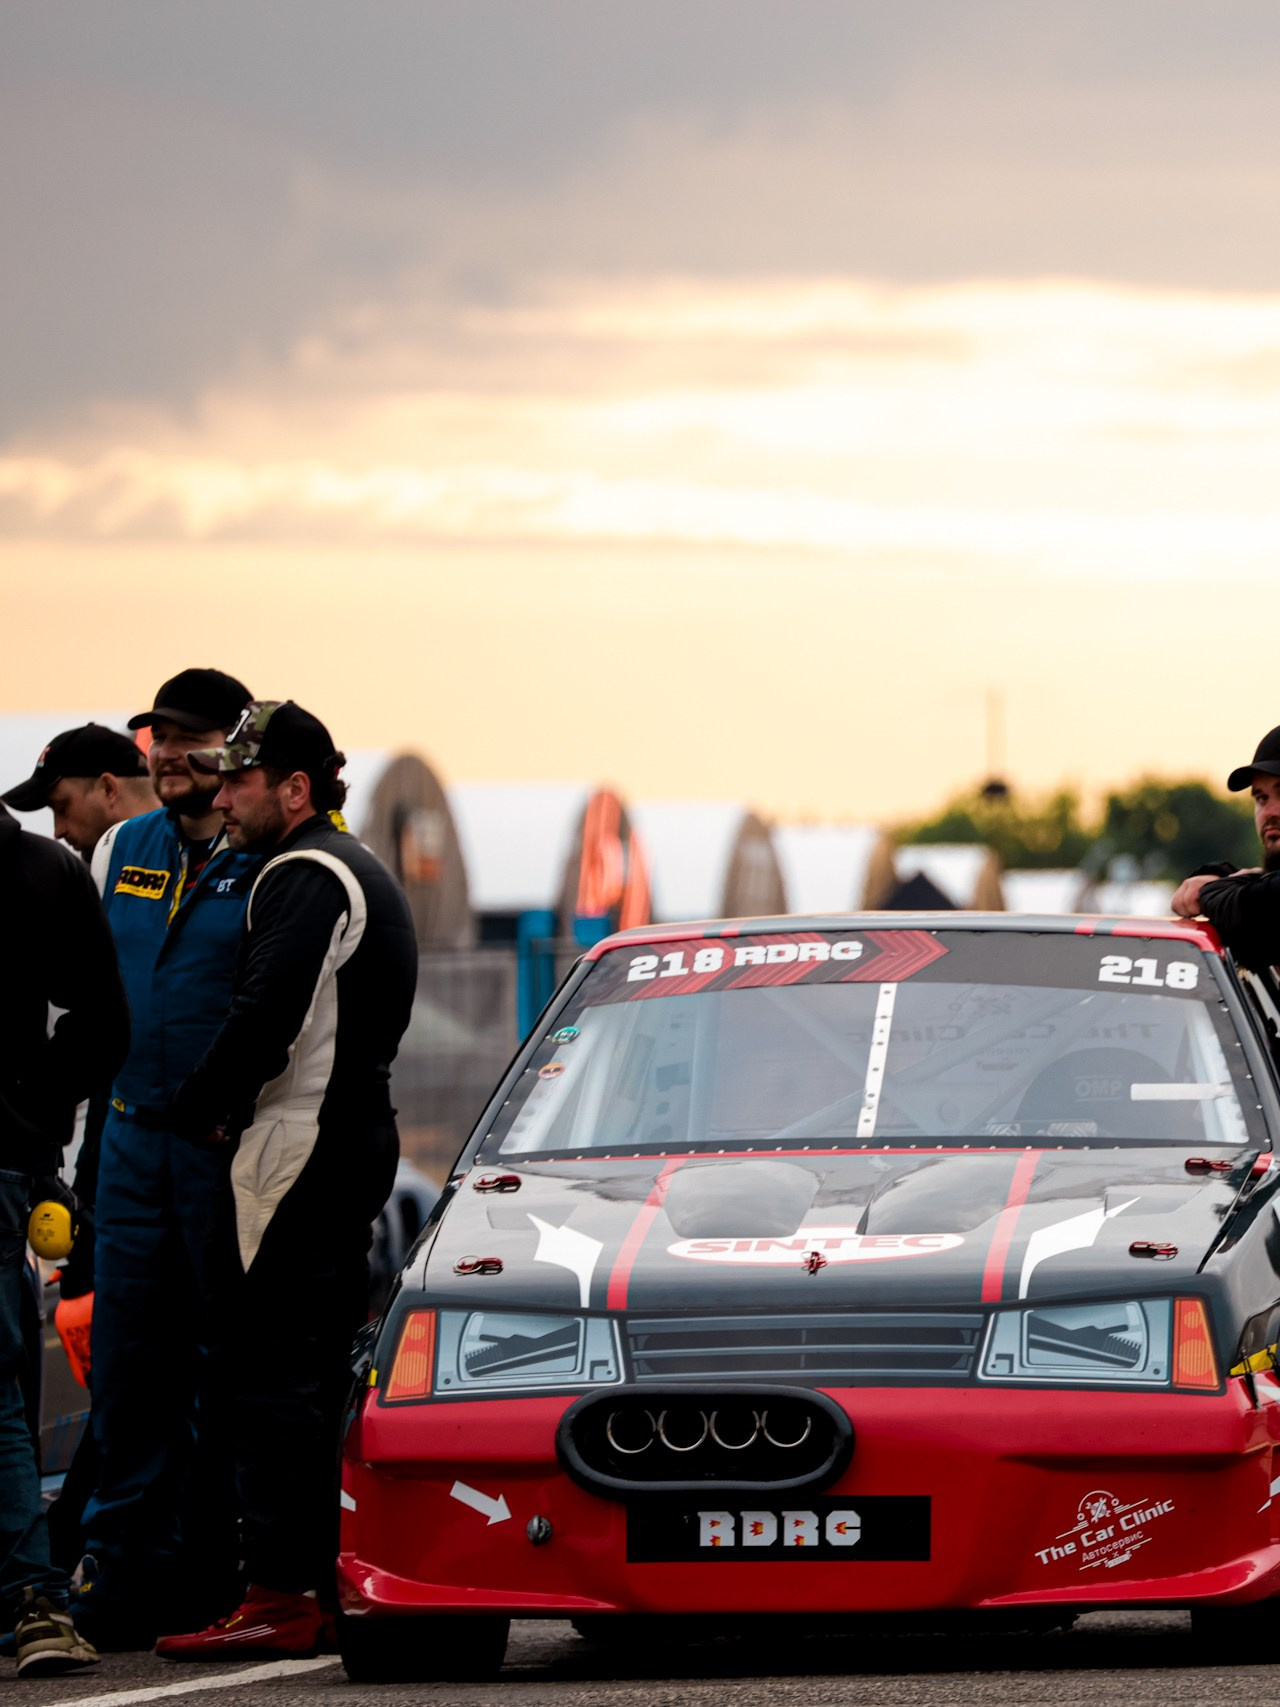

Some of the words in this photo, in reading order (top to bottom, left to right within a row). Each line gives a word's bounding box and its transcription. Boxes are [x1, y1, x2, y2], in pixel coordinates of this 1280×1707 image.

[627, 947, 723, 982] 218
[734, 941, 863, 966] RDRC
[1098, 955, 1199, 990] 218
[1075, 1079, 1122, 1097] OMP
[687, 1235, 944, 1254] SINTEC
[697, 1510, 861, 1546] RDRC
[1035, 1541, 1077, 1564] The
[1080, 1525, 1114, 1547] Car
[1119, 1499, 1175, 1531] Clinic
[1082, 1531, 1144, 1562] Автосервис
